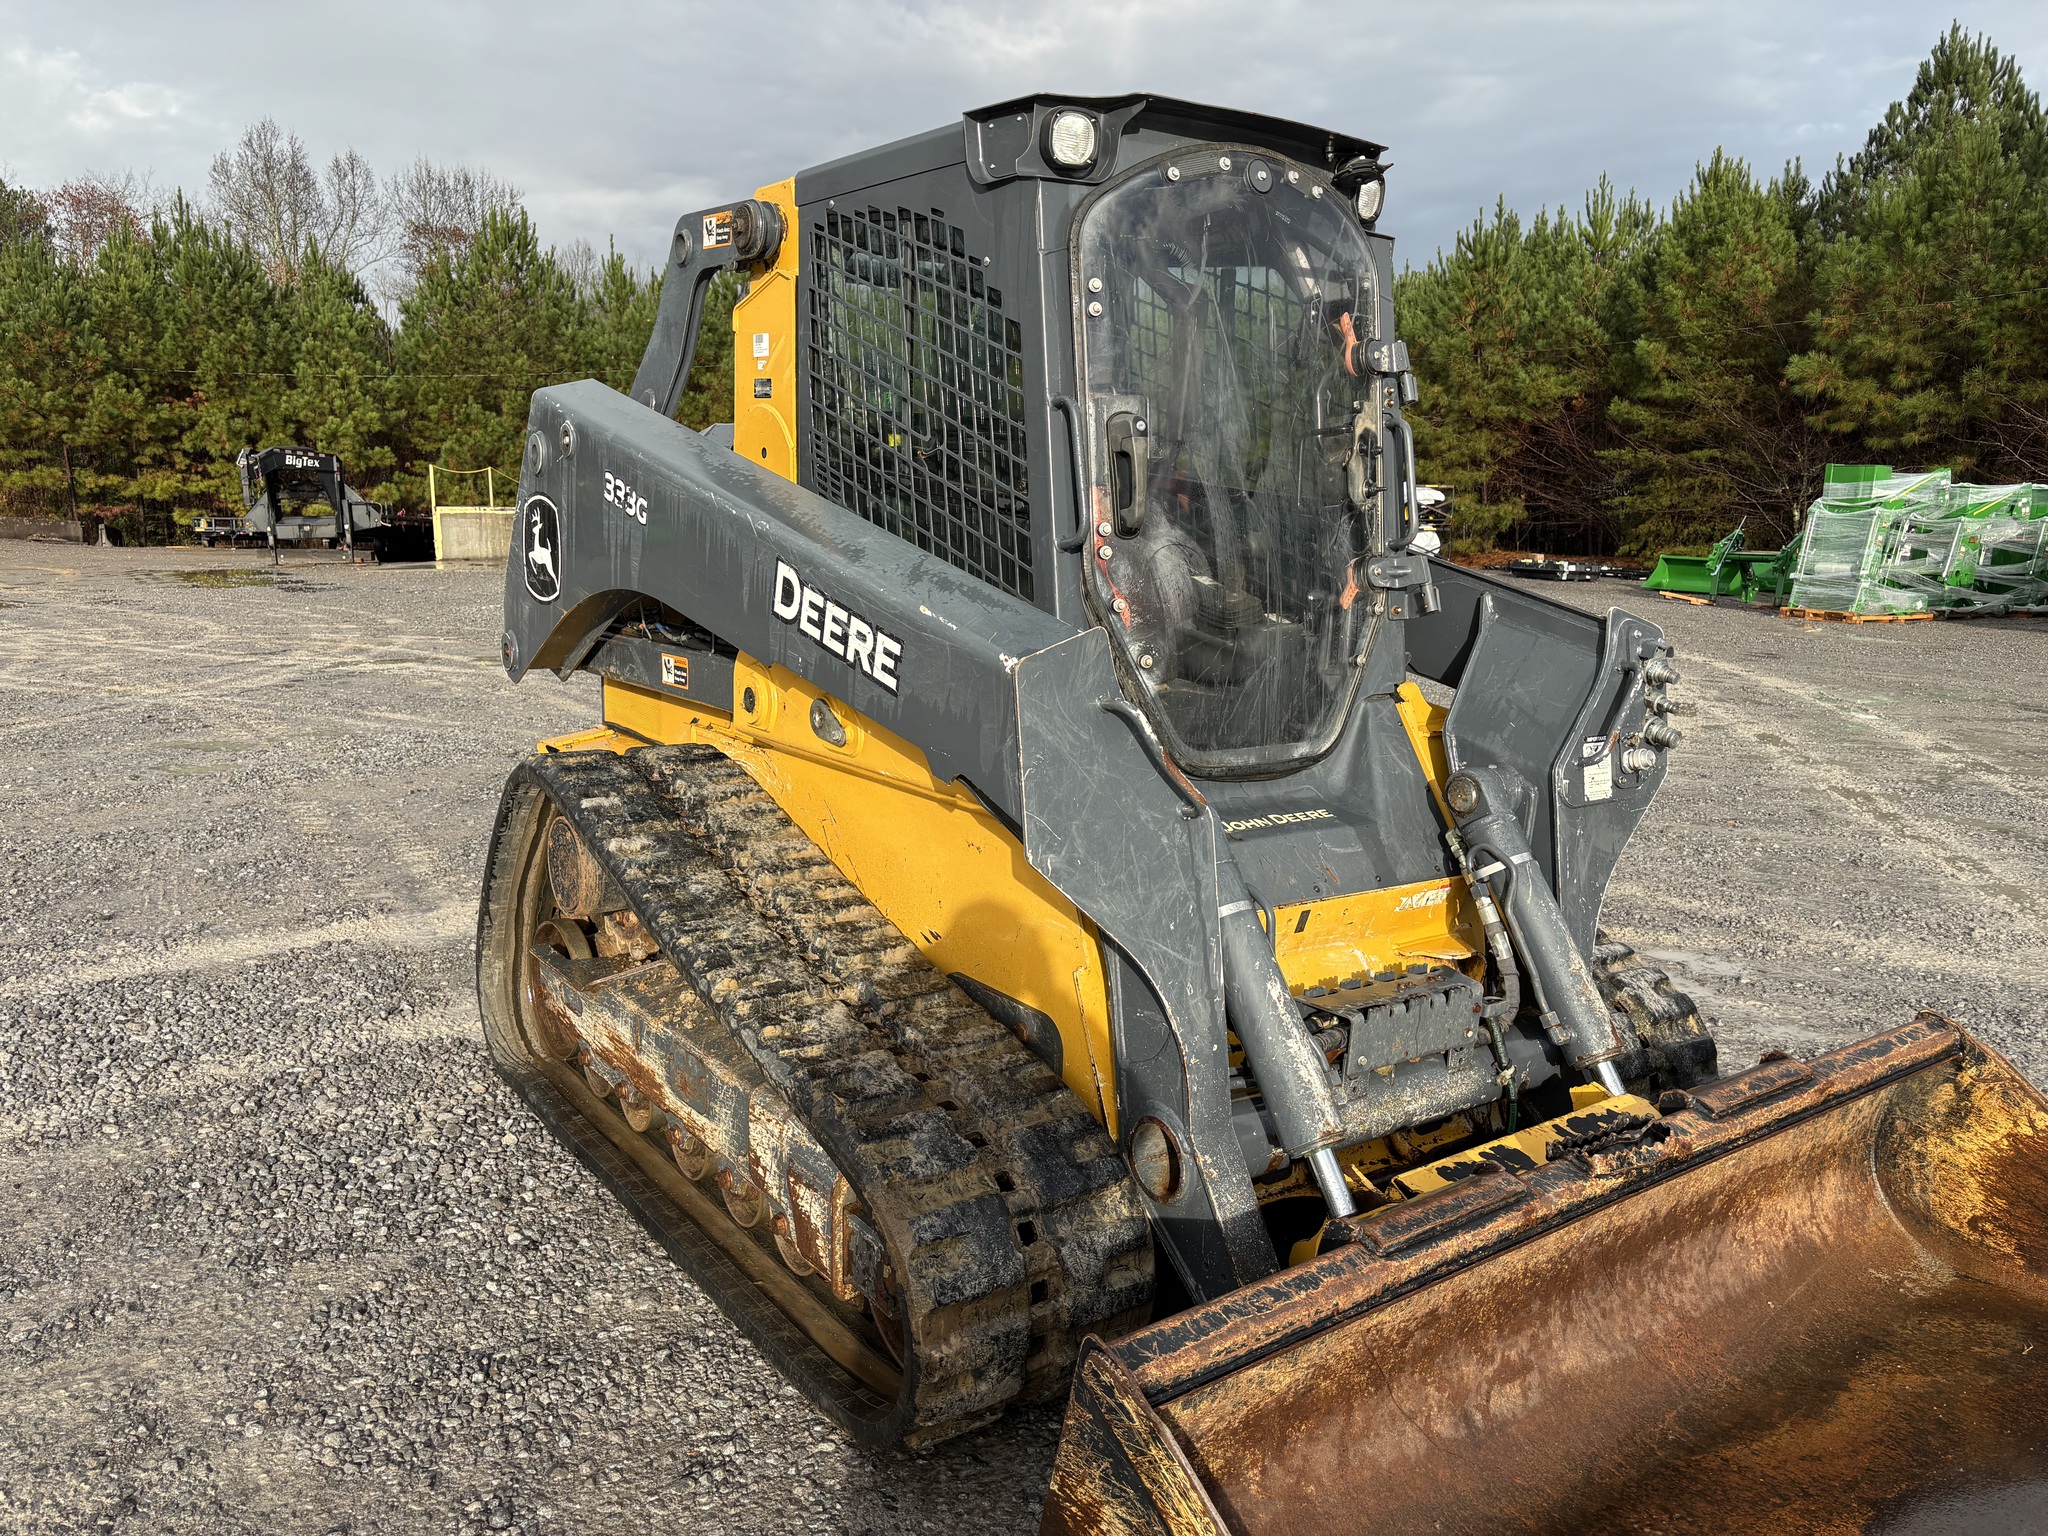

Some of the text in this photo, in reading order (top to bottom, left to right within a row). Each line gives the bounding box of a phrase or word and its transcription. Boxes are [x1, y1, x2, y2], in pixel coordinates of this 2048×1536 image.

[285, 454, 321, 468] BigTex
[773, 559, 902, 693] DEERE
[1221, 808, 1335, 833] JOHN DEERE
